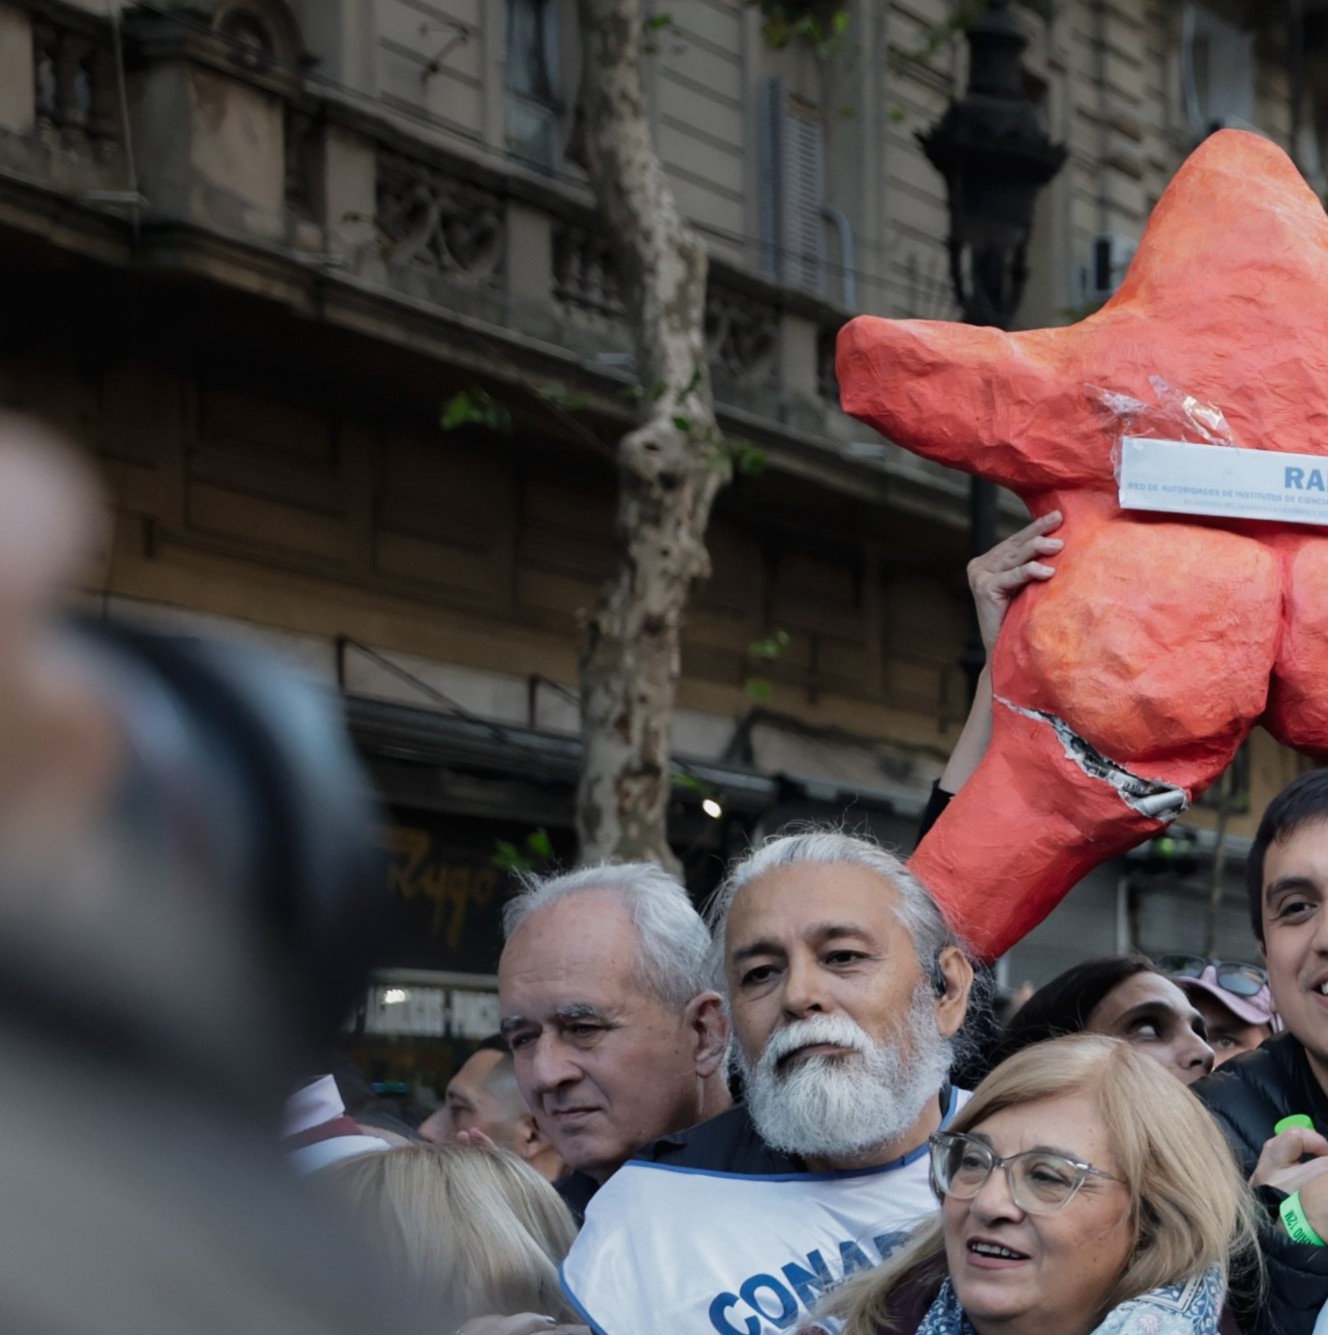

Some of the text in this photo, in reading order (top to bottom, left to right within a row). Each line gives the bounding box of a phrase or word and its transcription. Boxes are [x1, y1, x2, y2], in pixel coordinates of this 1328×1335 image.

[1127, 482, 1146, 491] RED
[1148, 484, 1159, 492] DE
[1161, 485, 1220, 496] AUTORIDADES
[1222, 490, 1233, 498] DE
[1235, 491, 1282, 503] INSTITUTOS
[1285, 495, 1296, 503] DE
